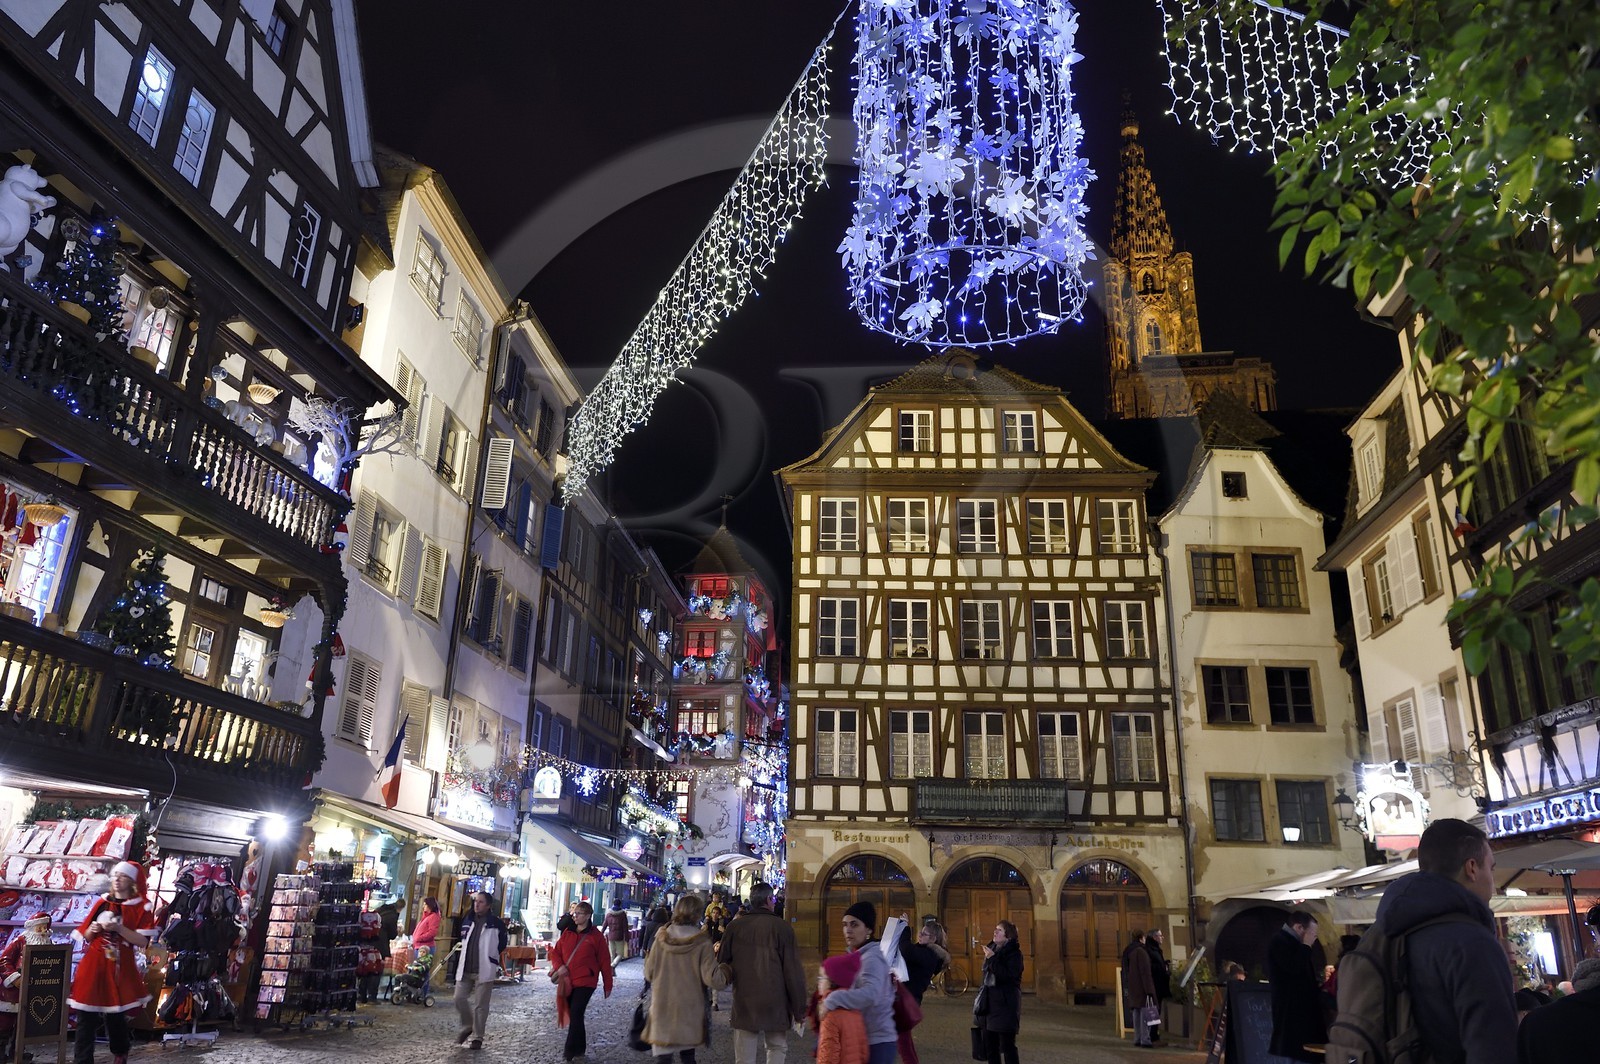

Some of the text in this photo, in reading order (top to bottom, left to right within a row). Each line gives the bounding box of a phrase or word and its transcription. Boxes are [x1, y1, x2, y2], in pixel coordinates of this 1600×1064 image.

[832, 829, 910, 843] Restaurant
[1065, 834, 1145, 849] Adelshoffen
[32, 956, 61, 968] Boutique
[34, 976, 60, 985] niveaux
